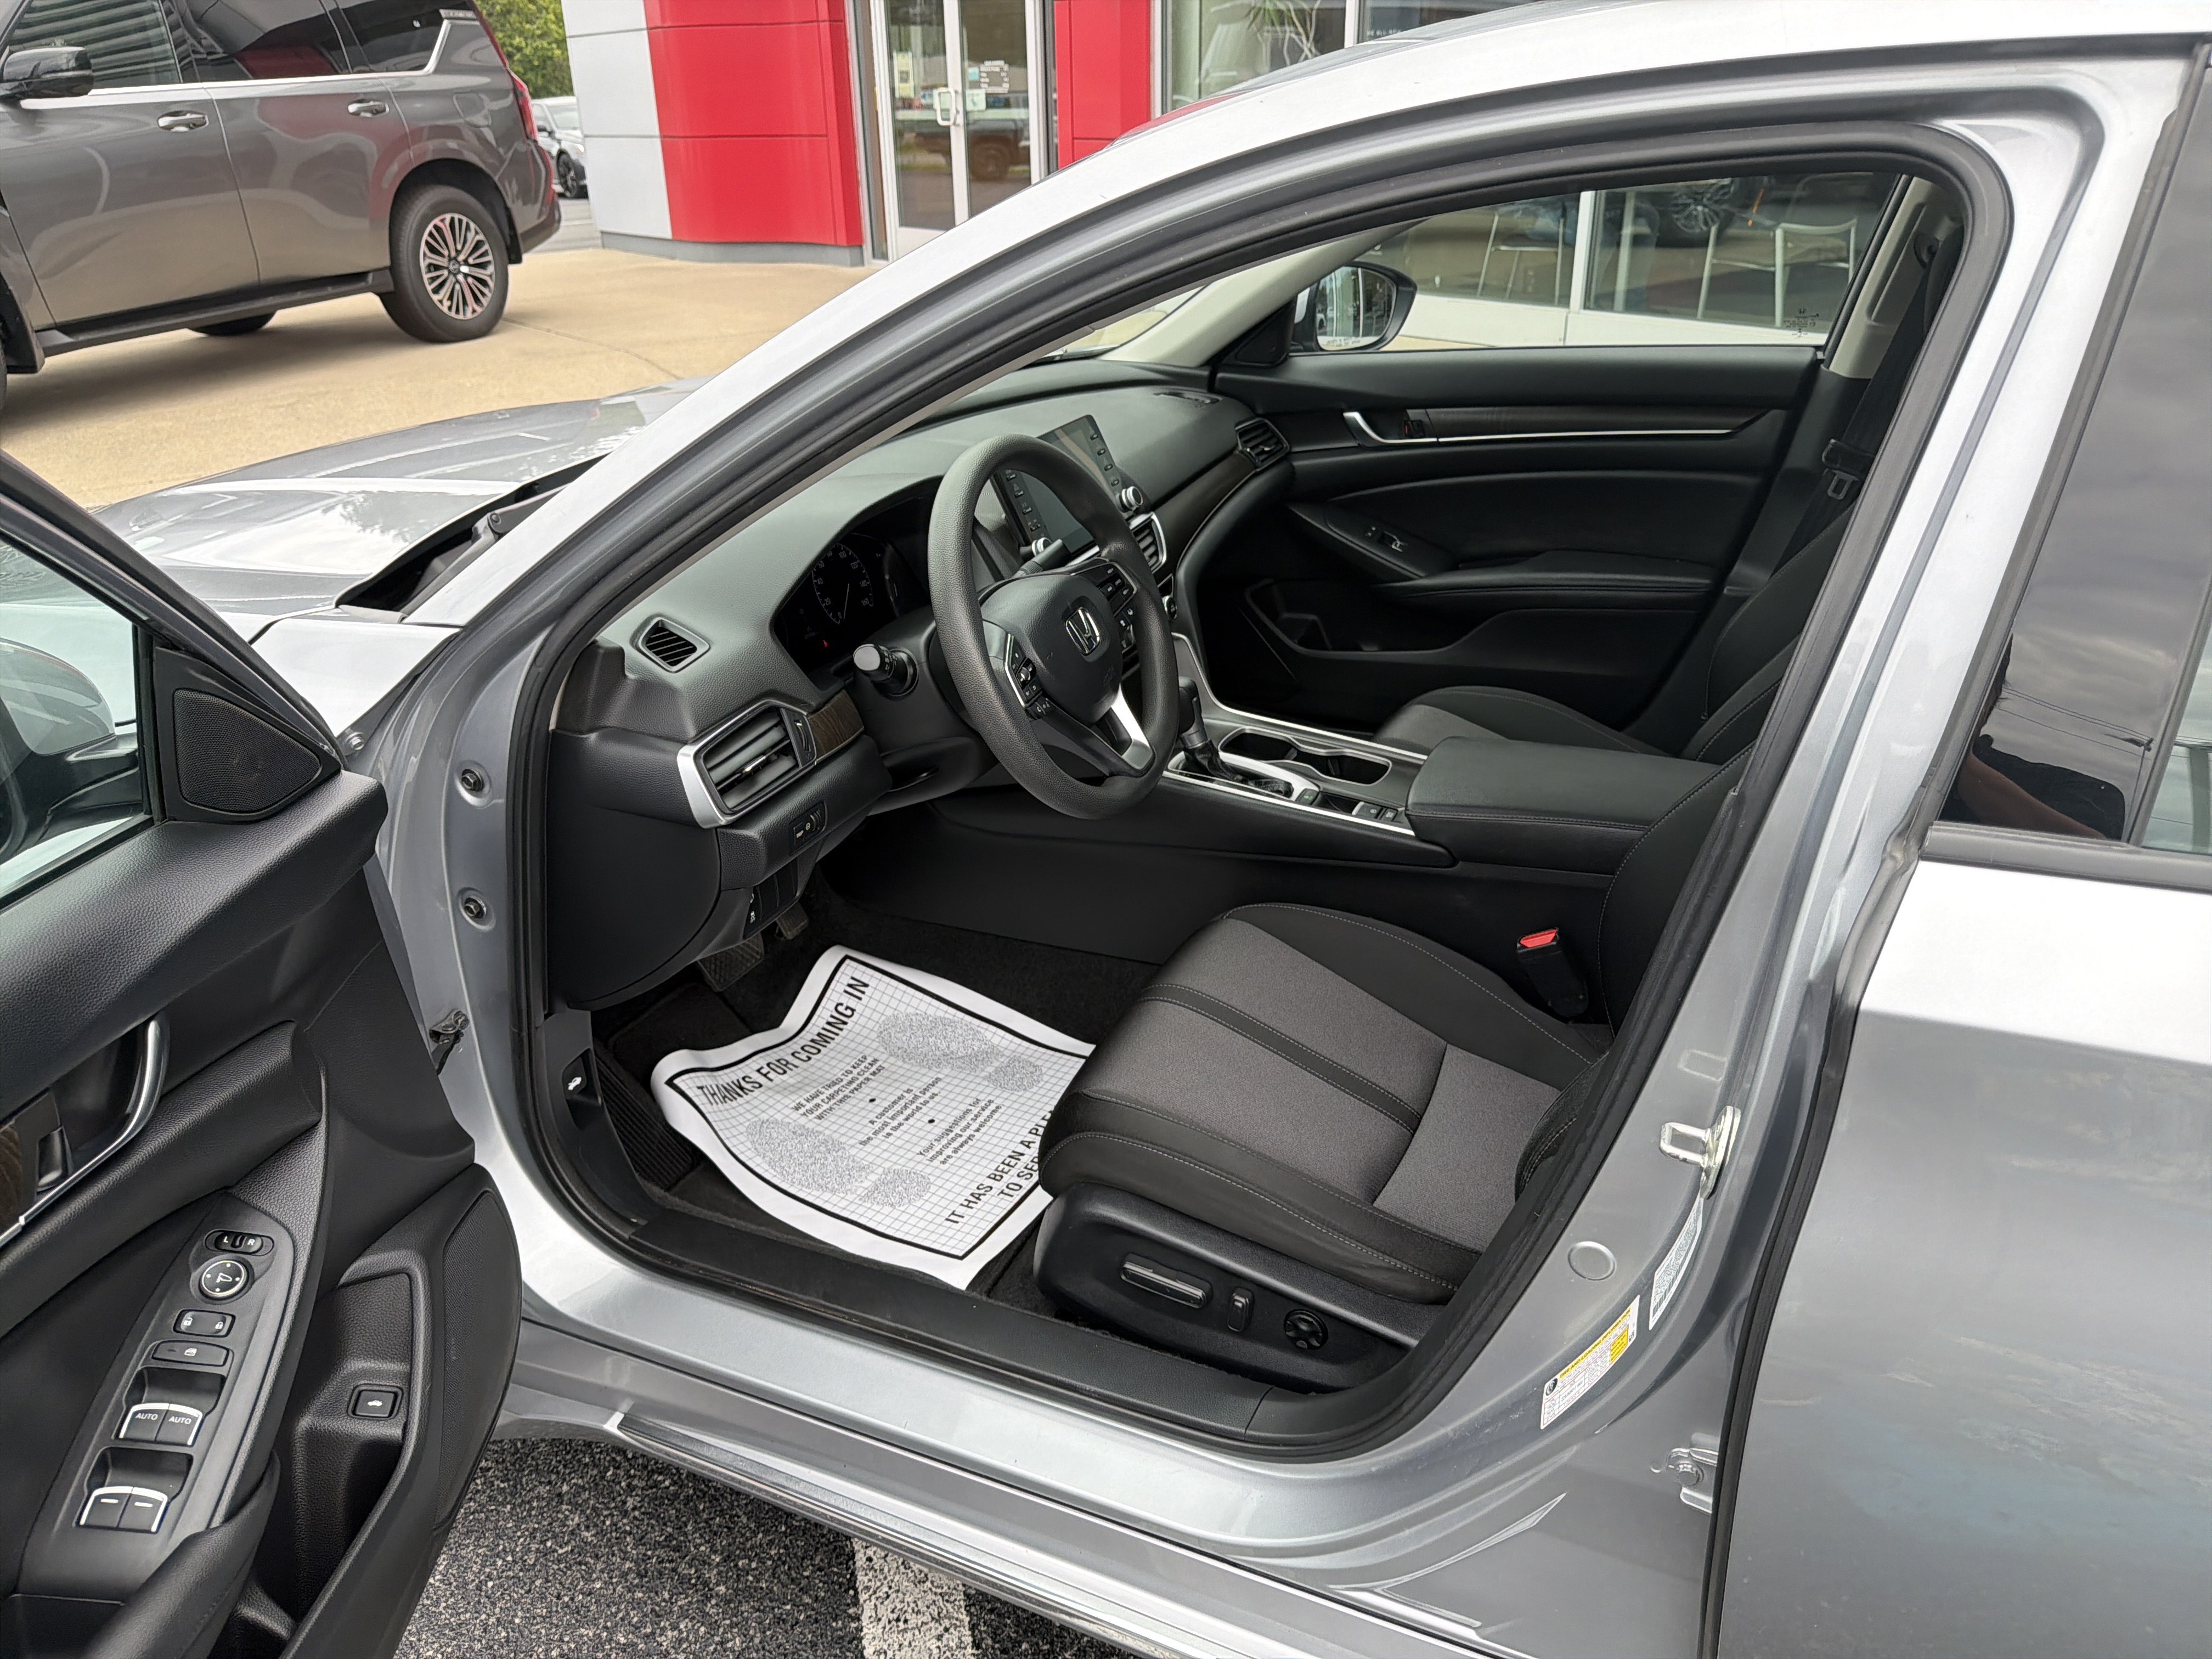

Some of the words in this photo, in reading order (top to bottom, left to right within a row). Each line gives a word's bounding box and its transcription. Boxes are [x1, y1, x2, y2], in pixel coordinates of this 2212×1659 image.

[697, 1075, 763, 1105] THANKS
[755, 1058, 799, 1082] FOR
[791, 1002, 856, 1063] COMING
[843, 976, 870, 1001] IN
[792, 1101, 806, 1111] WE
[804, 1088, 825, 1103] HAVE
[822, 1077, 844, 1091] TRIED
[840, 1069, 853, 1077] TO
[850, 1055, 867, 1069] KEEP
[800, 1102, 822, 1117] YOUR
[821, 1076, 859, 1104] CARPETING
[857, 1058, 879, 1076] CLEAN
[814, 1105, 836, 1120] WITH
[833, 1094, 851, 1106] THIS
[849, 1077, 872, 1094] PAPER
[870, 1064, 885, 1076] MAT
[859, 1136, 873, 1146] the
[872, 1121, 891, 1136] most
[887, 1094, 921, 1121] important
[919, 1077, 942, 1095] person
[876, 1094, 906, 1120] customer
[890, 1122, 904, 1132] the
[902, 1105, 922, 1121] world
[928, 1091, 941, 1099] us.
[917, 1143, 935, 1156] Your
[934, 1108, 972, 1142] suggestions
[968, 1098, 981, 1107] for
[926, 1133, 963, 1162] improving
[960, 1122, 973, 1133] our
[970, 1099, 994, 1122] service
[940, 1155, 953, 1165] are
[952, 1134, 975, 1154] always
[973, 1104, 1005, 1132] welcome.
[945, 1210, 965, 1224] IT
[960, 1183, 993, 1209] HAS
[986, 1150, 1025, 1182] BEEN
[1019, 1140, 1036, 1149] A
[997, 1182, 1023, 1198] TO
[1560, 1368, 1570, 1378] TIRE
[1571, 1358, 1581, 1370] AND
[1581, 1340, 1601, 1360] LOADING
[1601, 1308, 1630, 1341] INFORMATION
[168, 1416, 191, 1424] AUTO
